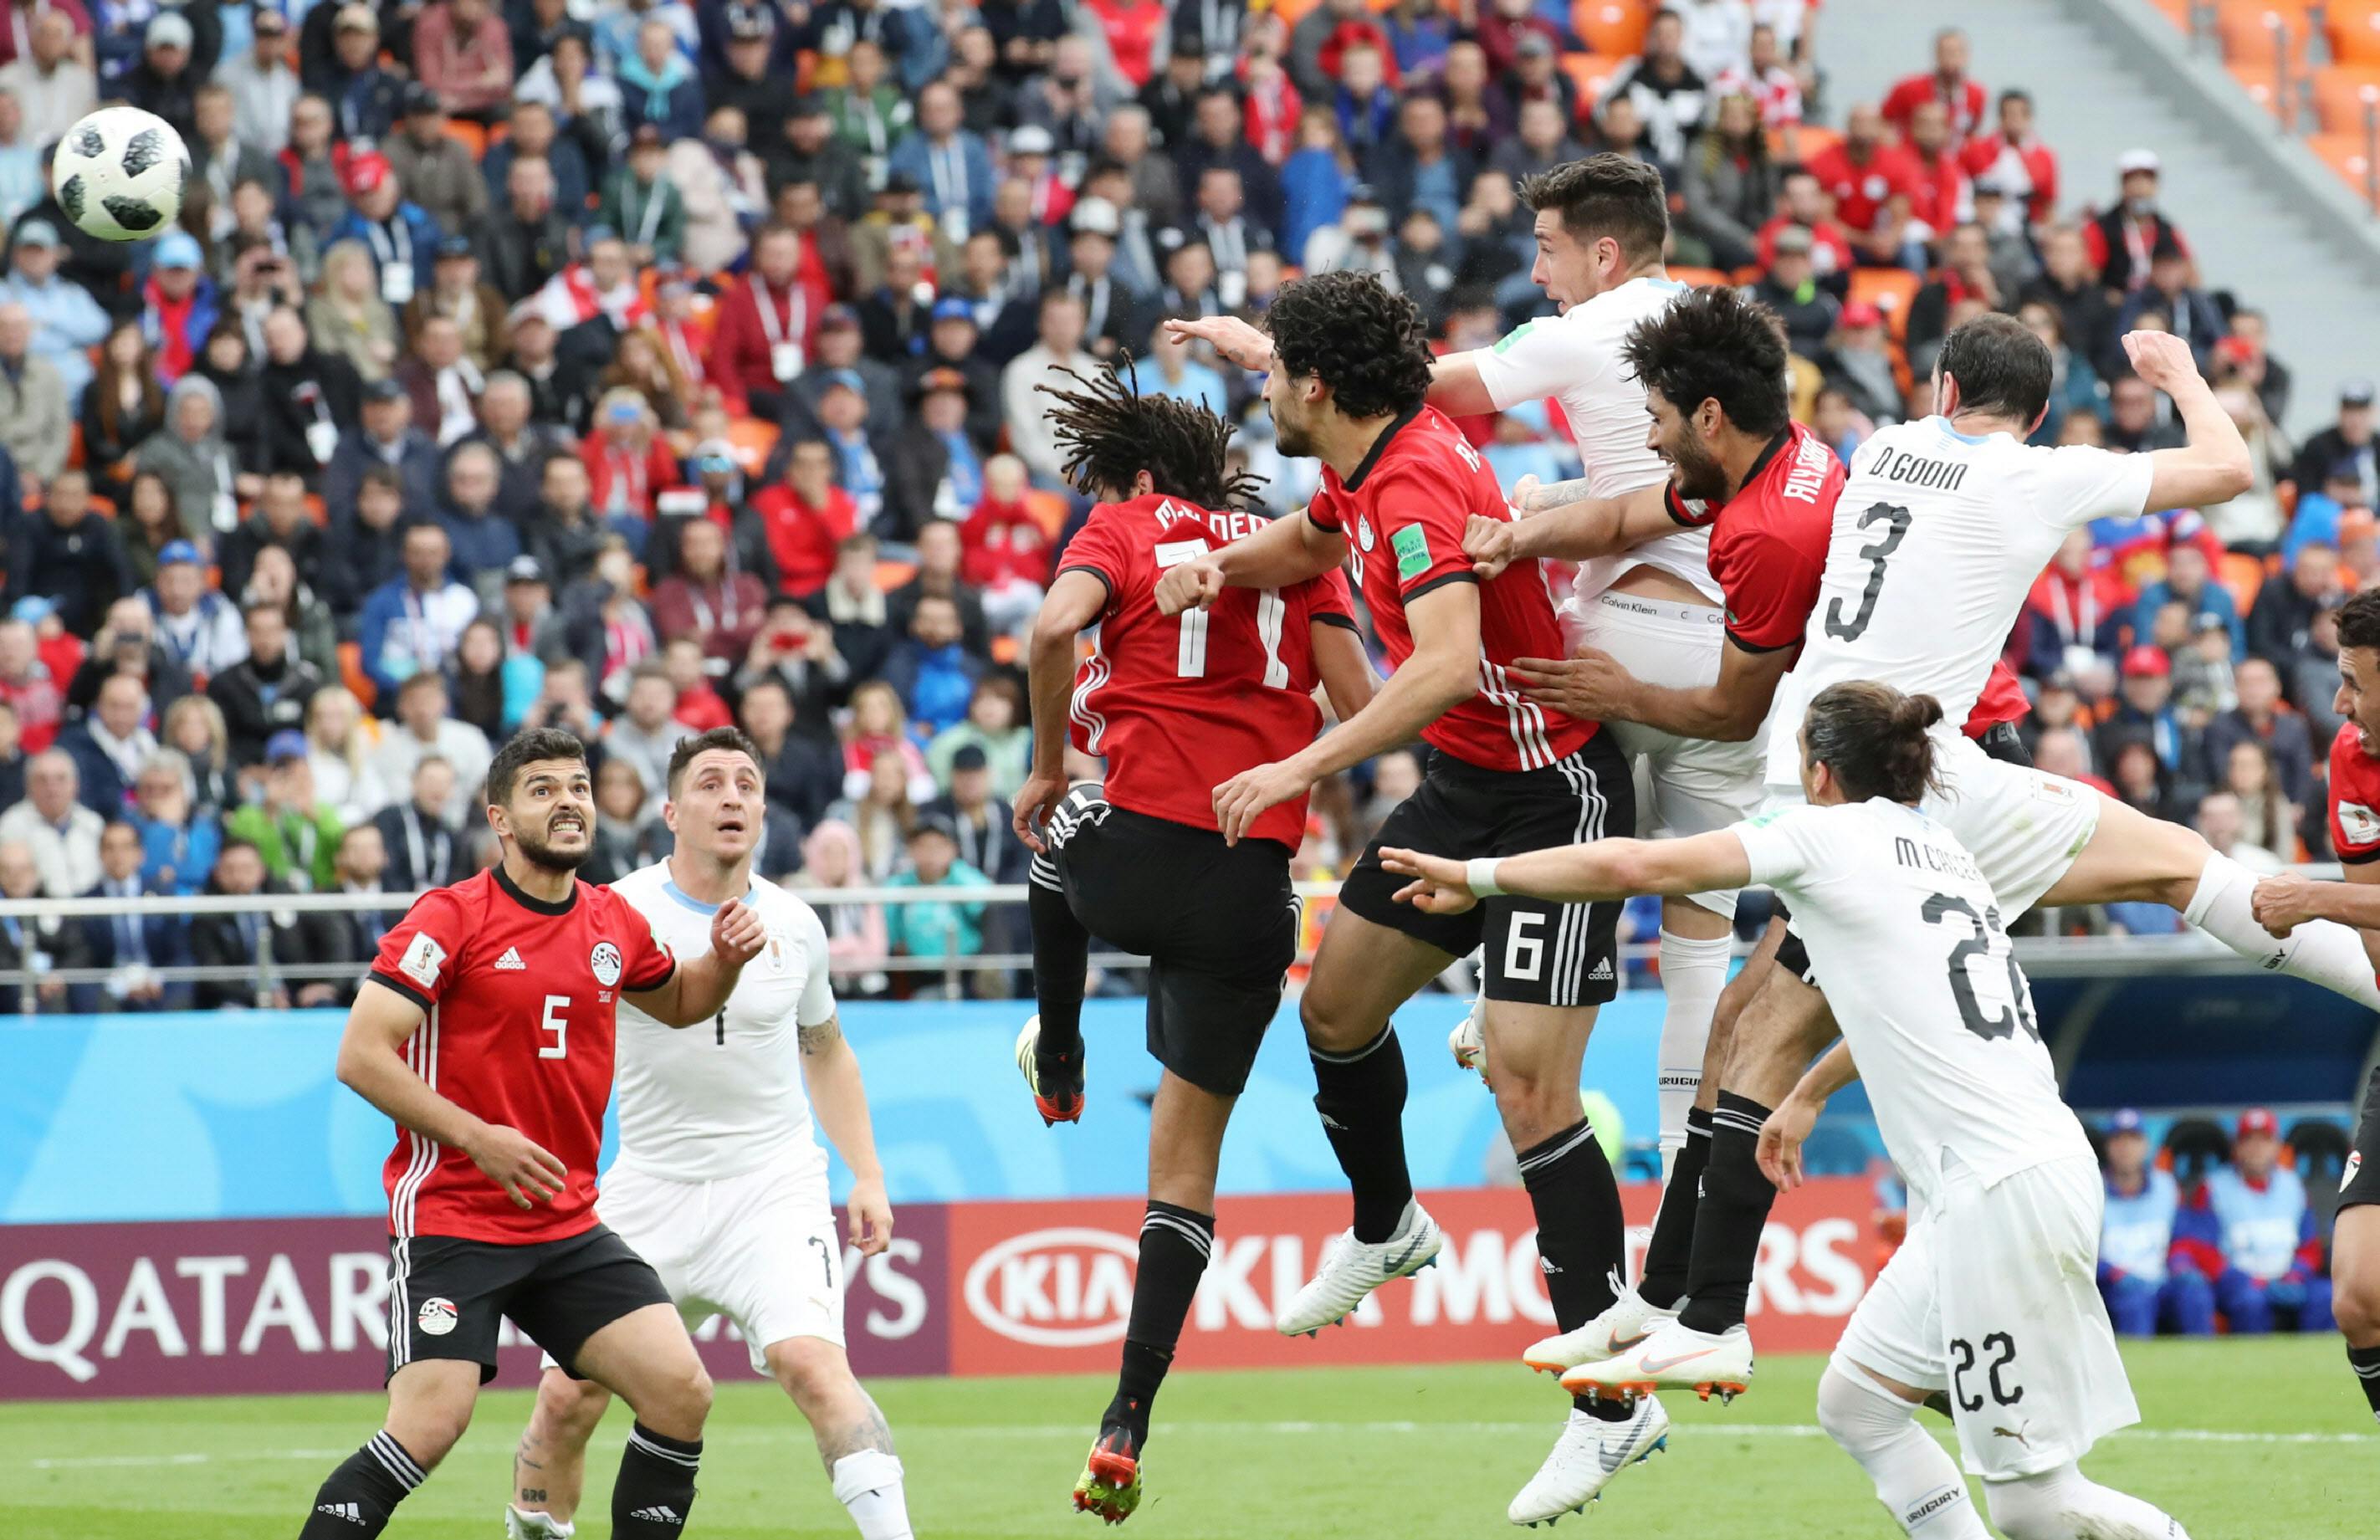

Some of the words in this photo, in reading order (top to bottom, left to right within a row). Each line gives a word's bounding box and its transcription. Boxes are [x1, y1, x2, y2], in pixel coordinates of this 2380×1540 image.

[1601, 596, 1630, 611] Calvin
[1631, 602, 1657, 615] Klein
[1825, 502, 1913, 643] 3
[494, 961, 527, 970] adidas
[1504, 911, 1546, 982] 6
[538, 994, 571, 1060] 5
[0, 1253, 390, 1383] QATAR
[1001, 1253, 1135, 1322] KIA
[1950, 1331, 2024, 1412] 22
[630, 1511, 683, 1524] adidas
[1906, 1486, 1960, 1523] URUGUAY
